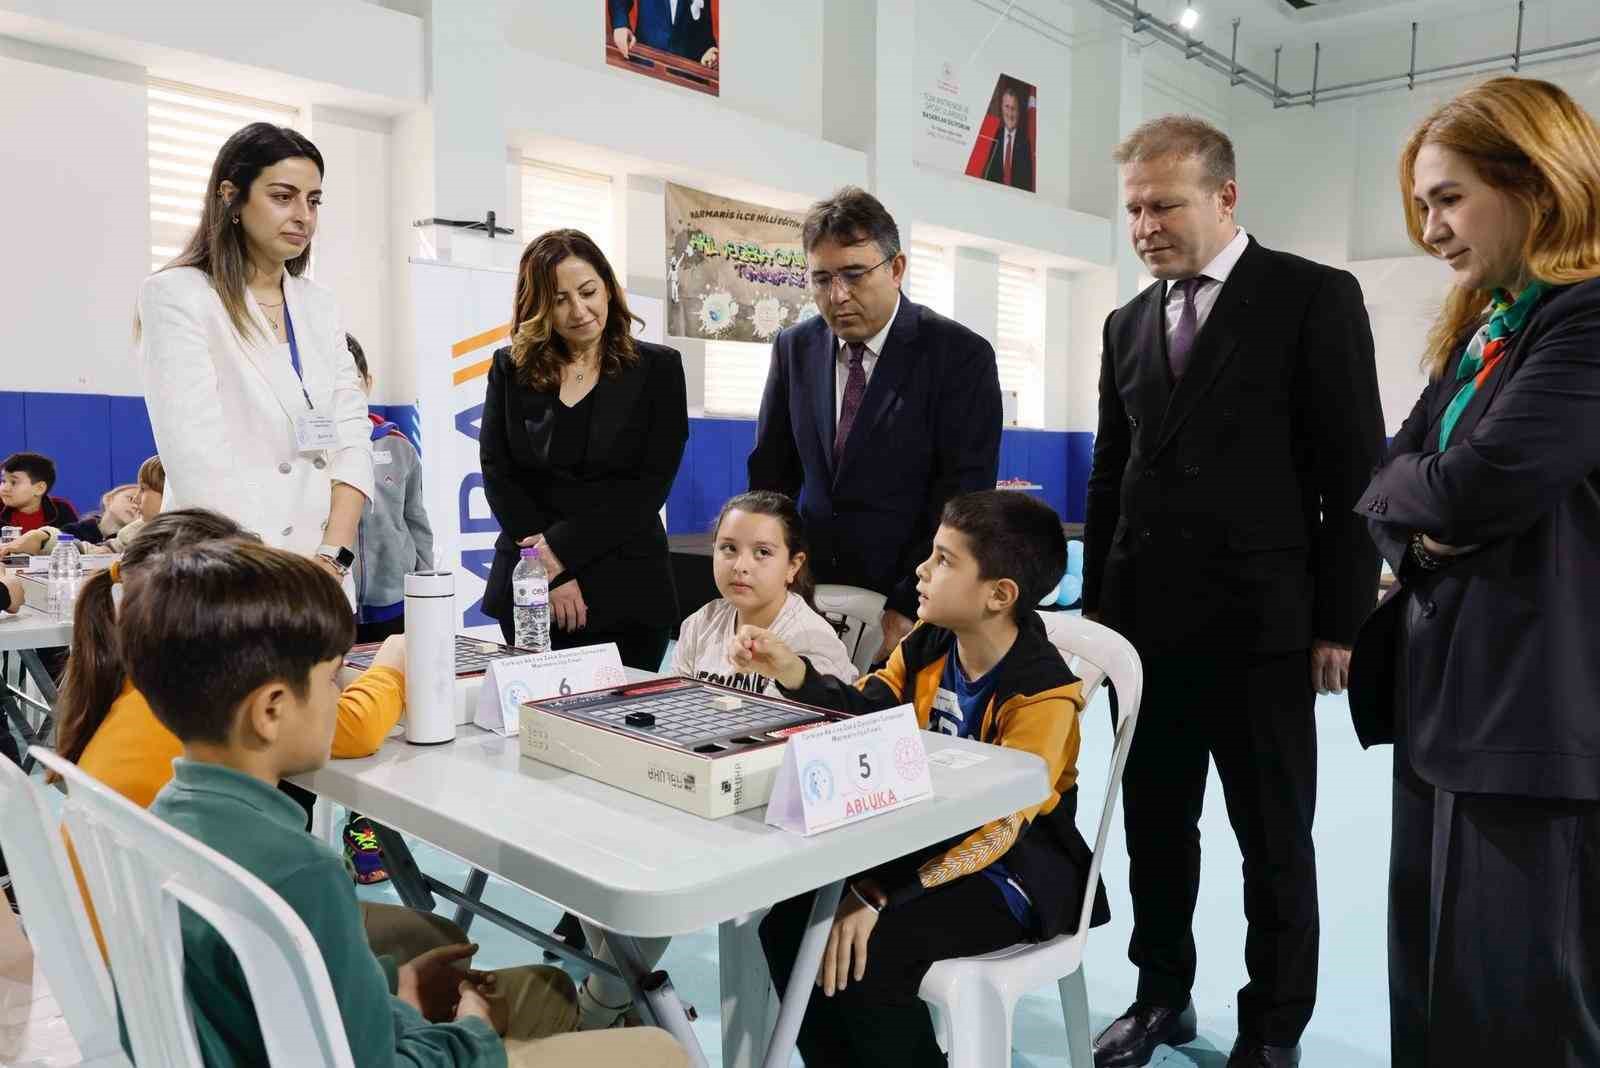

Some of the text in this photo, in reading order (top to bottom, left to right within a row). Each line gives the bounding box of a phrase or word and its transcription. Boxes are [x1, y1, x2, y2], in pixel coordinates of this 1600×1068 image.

[558, 677, 571, 696] 6
[858, 753, 871, 779] 5
[845, 789, 897, 817] ABLUKA
